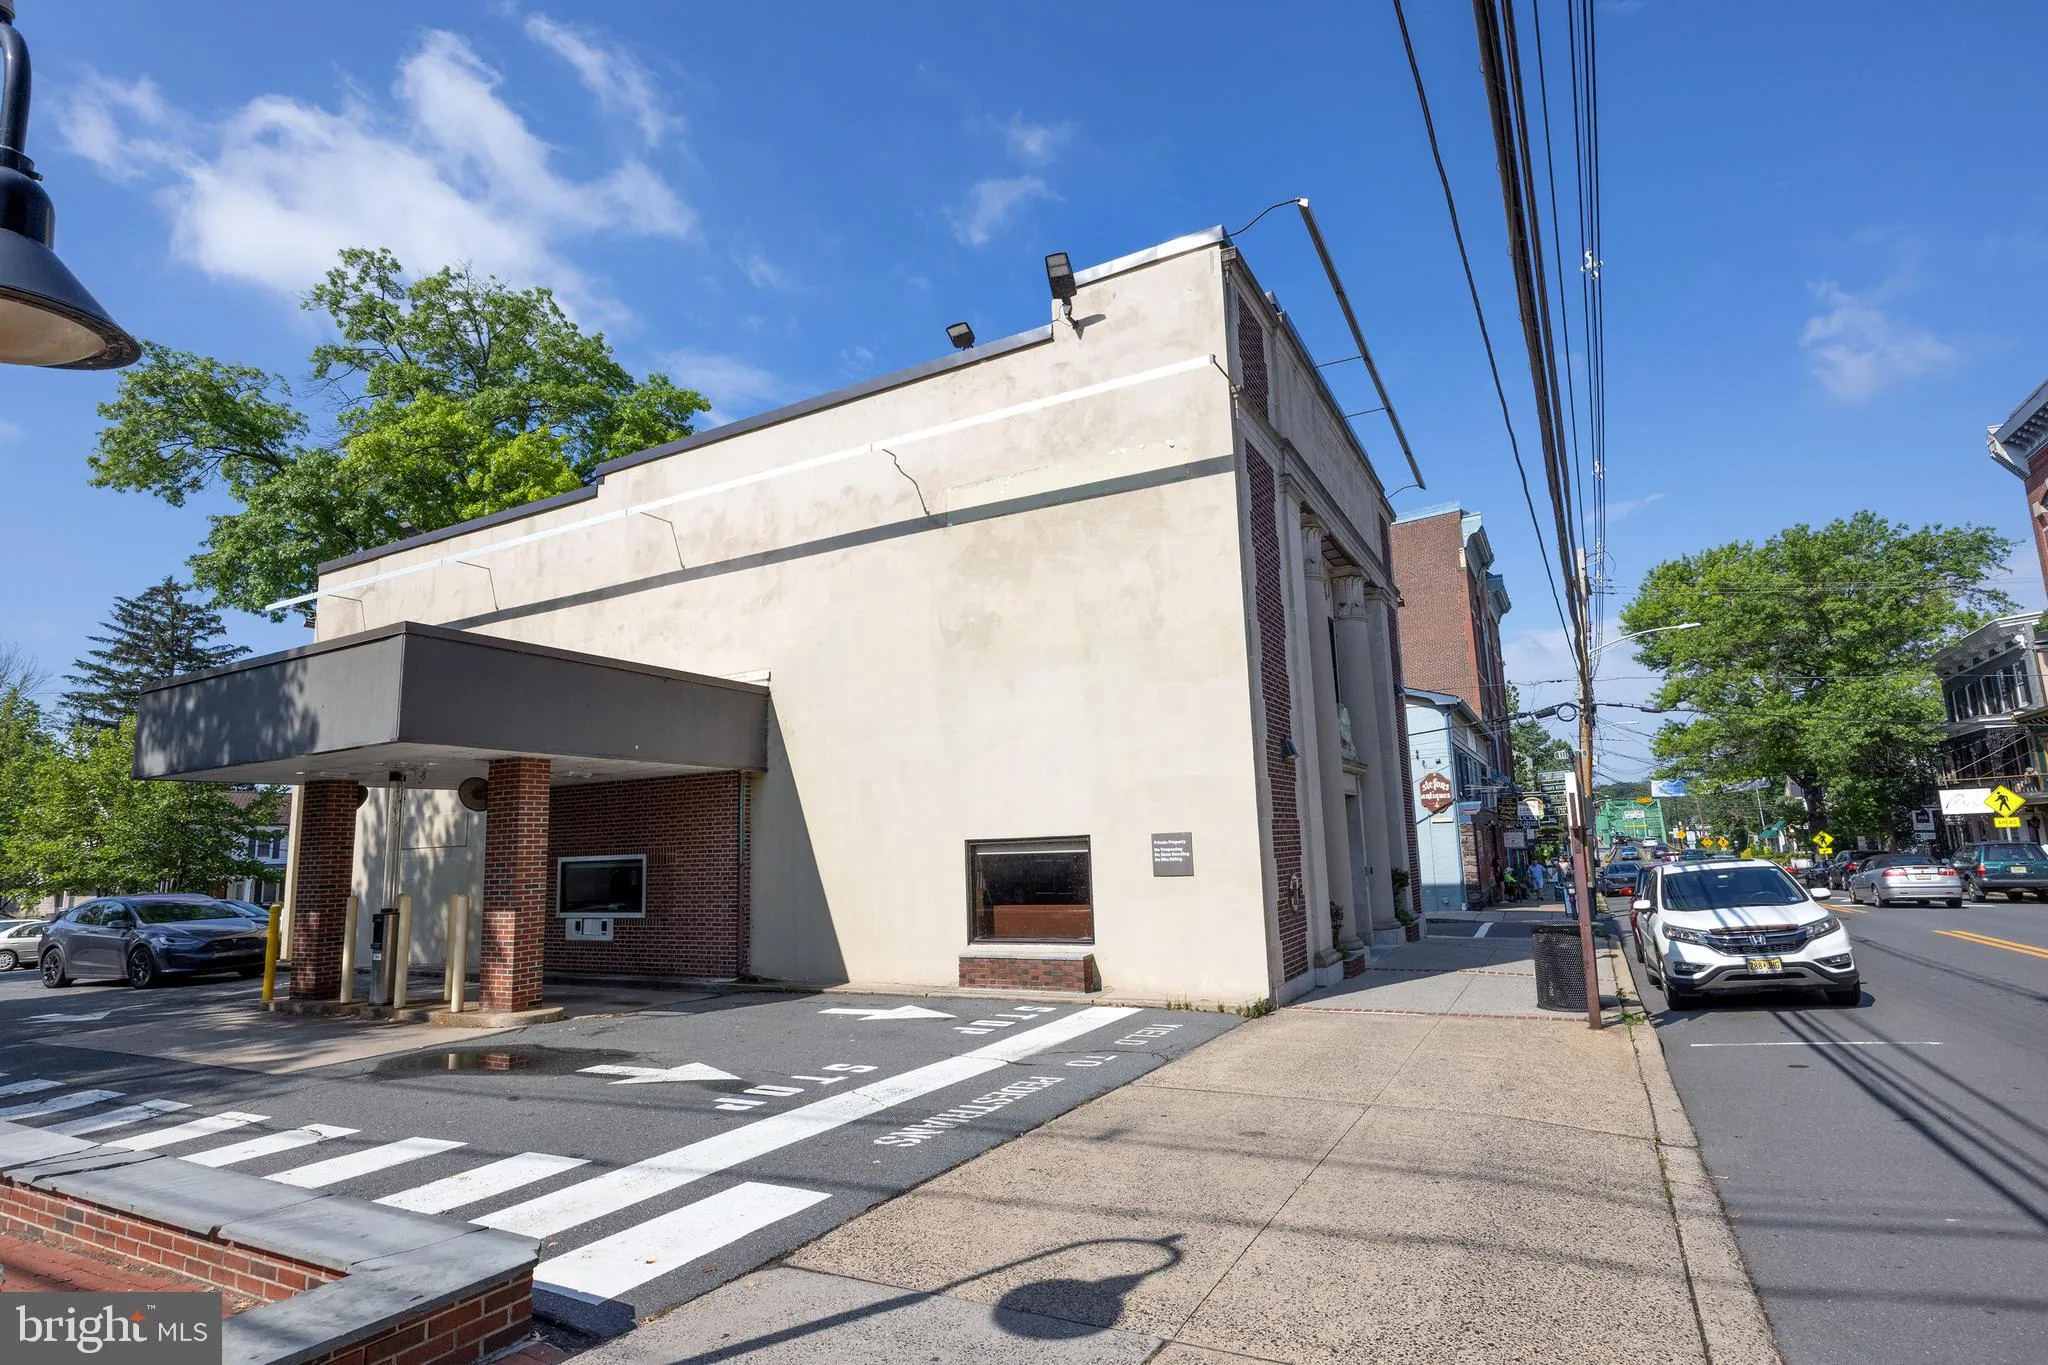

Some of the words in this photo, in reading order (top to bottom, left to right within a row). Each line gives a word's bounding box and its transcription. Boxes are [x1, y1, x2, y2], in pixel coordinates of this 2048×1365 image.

[1421, 791, 1451, 801] antiques
[1112, 1023, 1183, 1046] YIELD
[1065, 1054, 1117, 1067] TO
[712, 1063, 879, 1111] STOP
[873, 1076, 1066, 1147] PEDESTRIANS
